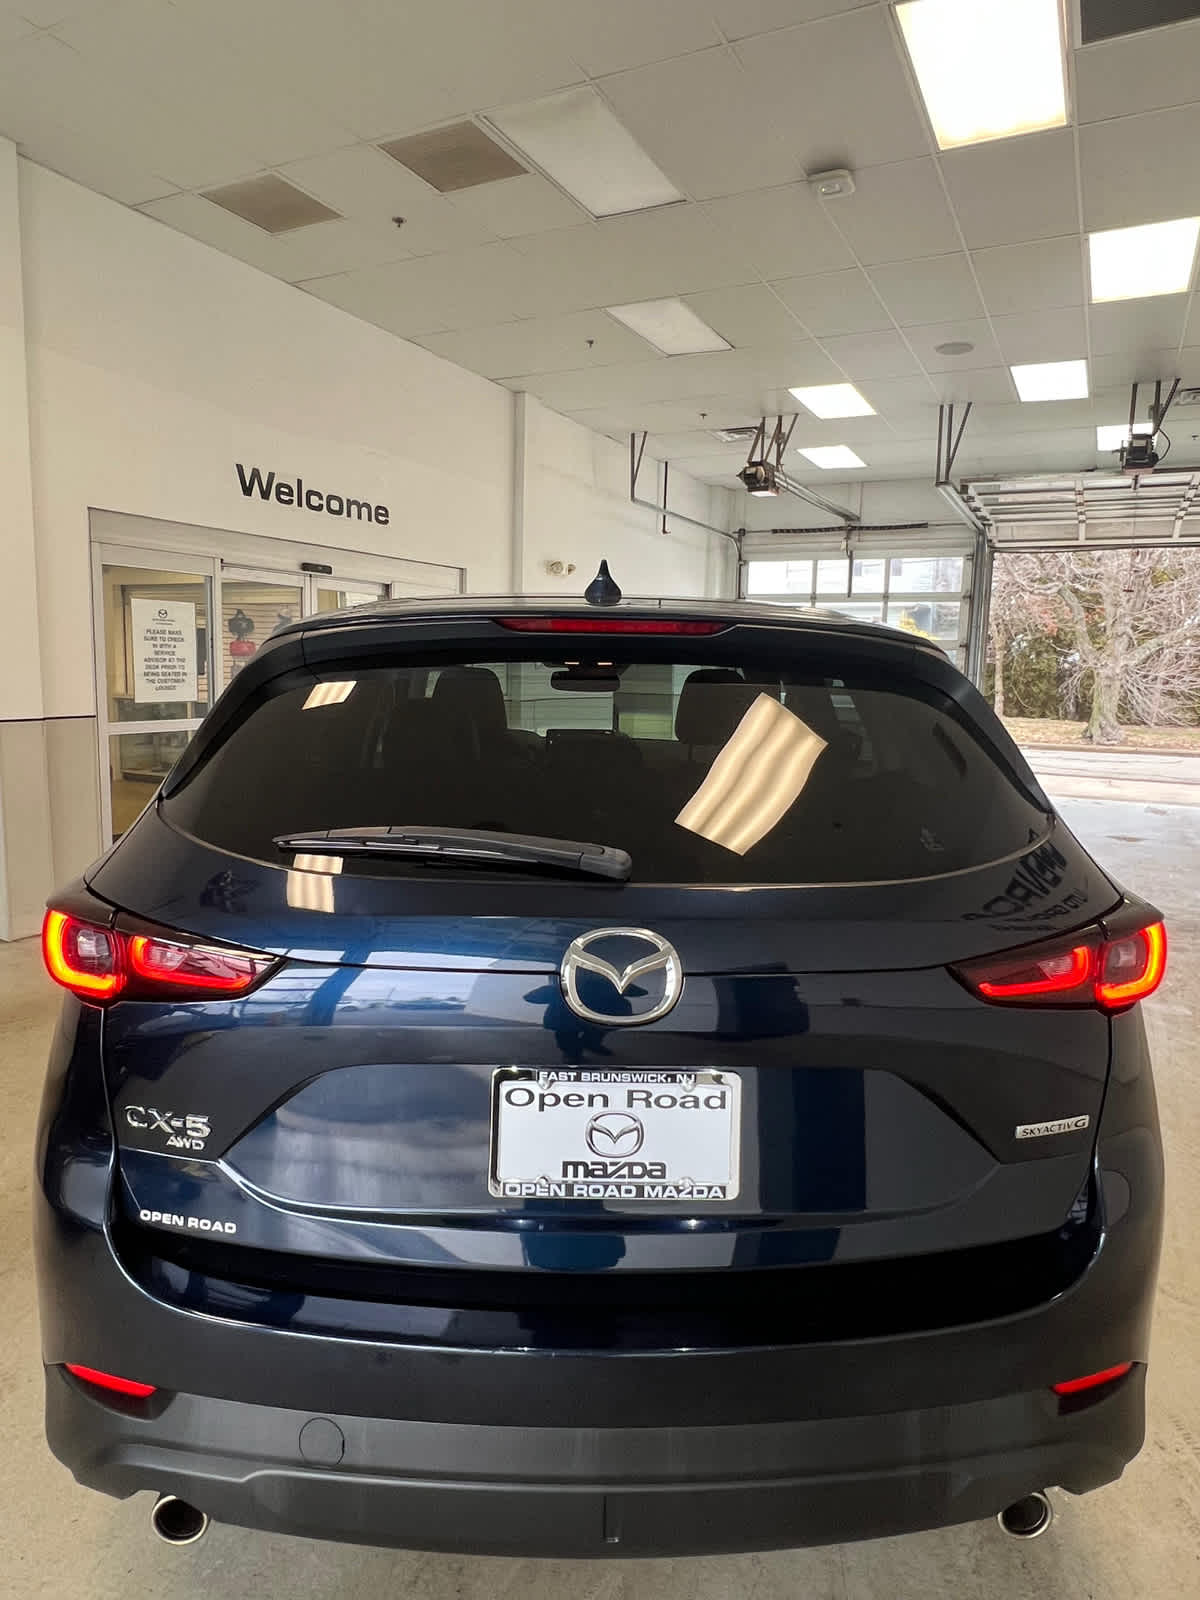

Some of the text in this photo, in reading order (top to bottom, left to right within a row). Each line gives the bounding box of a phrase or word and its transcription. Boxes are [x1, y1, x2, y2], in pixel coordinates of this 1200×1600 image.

[235, 463, 390, 525] Welcome
[676, 1074, 696, 1083] NJ
[504, 1087, 727, 1112] Open Road
[124, 1104, 212, 1139] CX-5
[165, 1135, 205, 1150] AWD
[504, 1183, 725, 1199] OPEN ROAD MAZDA
[139, 1209, 237, 1234] OPEN ROAD
